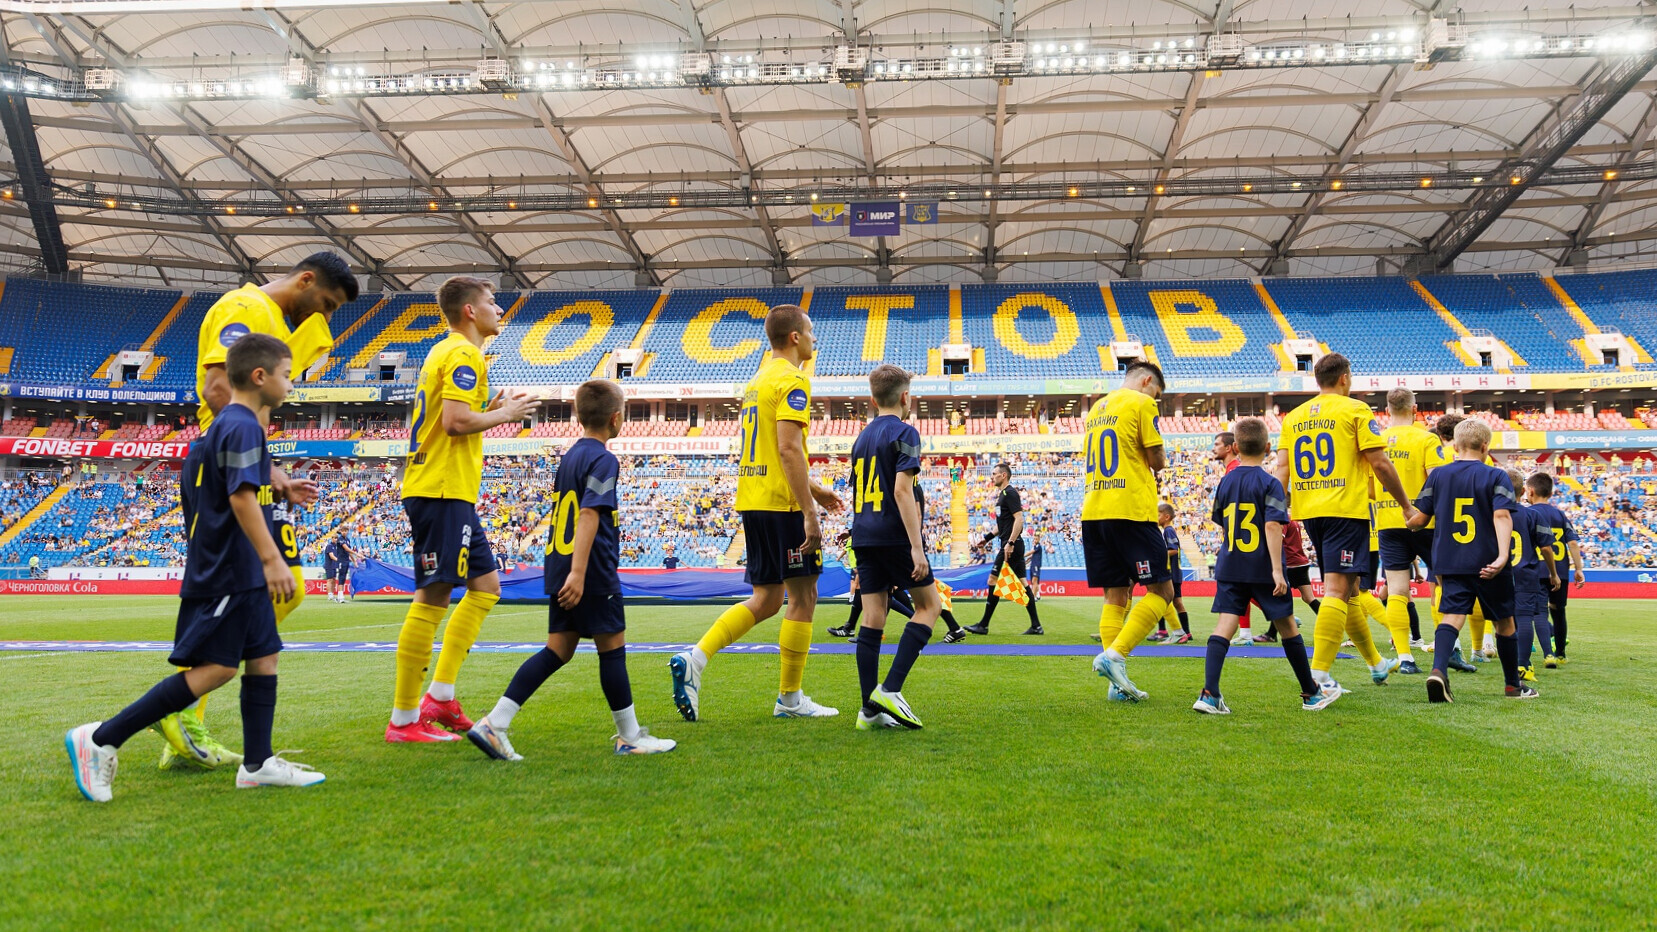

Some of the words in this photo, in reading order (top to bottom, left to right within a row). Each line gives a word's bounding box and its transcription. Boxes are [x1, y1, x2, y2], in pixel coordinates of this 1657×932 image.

[870, 211, 895, 220] МИР
[20, 386, 74, 398] ВСТУПАЙТЕ
[77, 388, 82, 398] В
[85, 388, 109, 399] КЛУБ
[112, 389, 176, 400] БОЛЕЛЬЩИКОВ
[842, 384, 871, 392] ЭЛЕКТР
[1293, 418, 1336, 434] ГОЛЕНКОВ
[11, 440, 98, 455] FONBET
[109, 442, 188, 457] FONBET
[268, 441, 297, 454] OSTOV
[606, 441, 719, 451] СТСЕЛЬМАШ
[1086, 428, 1119, 480] 40
[1294, 432, 1335, 479] 69
[854, 455, 884, 514] 14
[1223, 502, 1260, 553] 13
[1452, 497, 1476, 544] 5
[281, 523, 298, 559] 9
[457, 547, 469, 579] 6
[8, 583, 69, 593] ЧЕРНОГОЛОВКА
[72, 582, 98, 593] Cola
[1038, 583, 1065, 594] Cola
